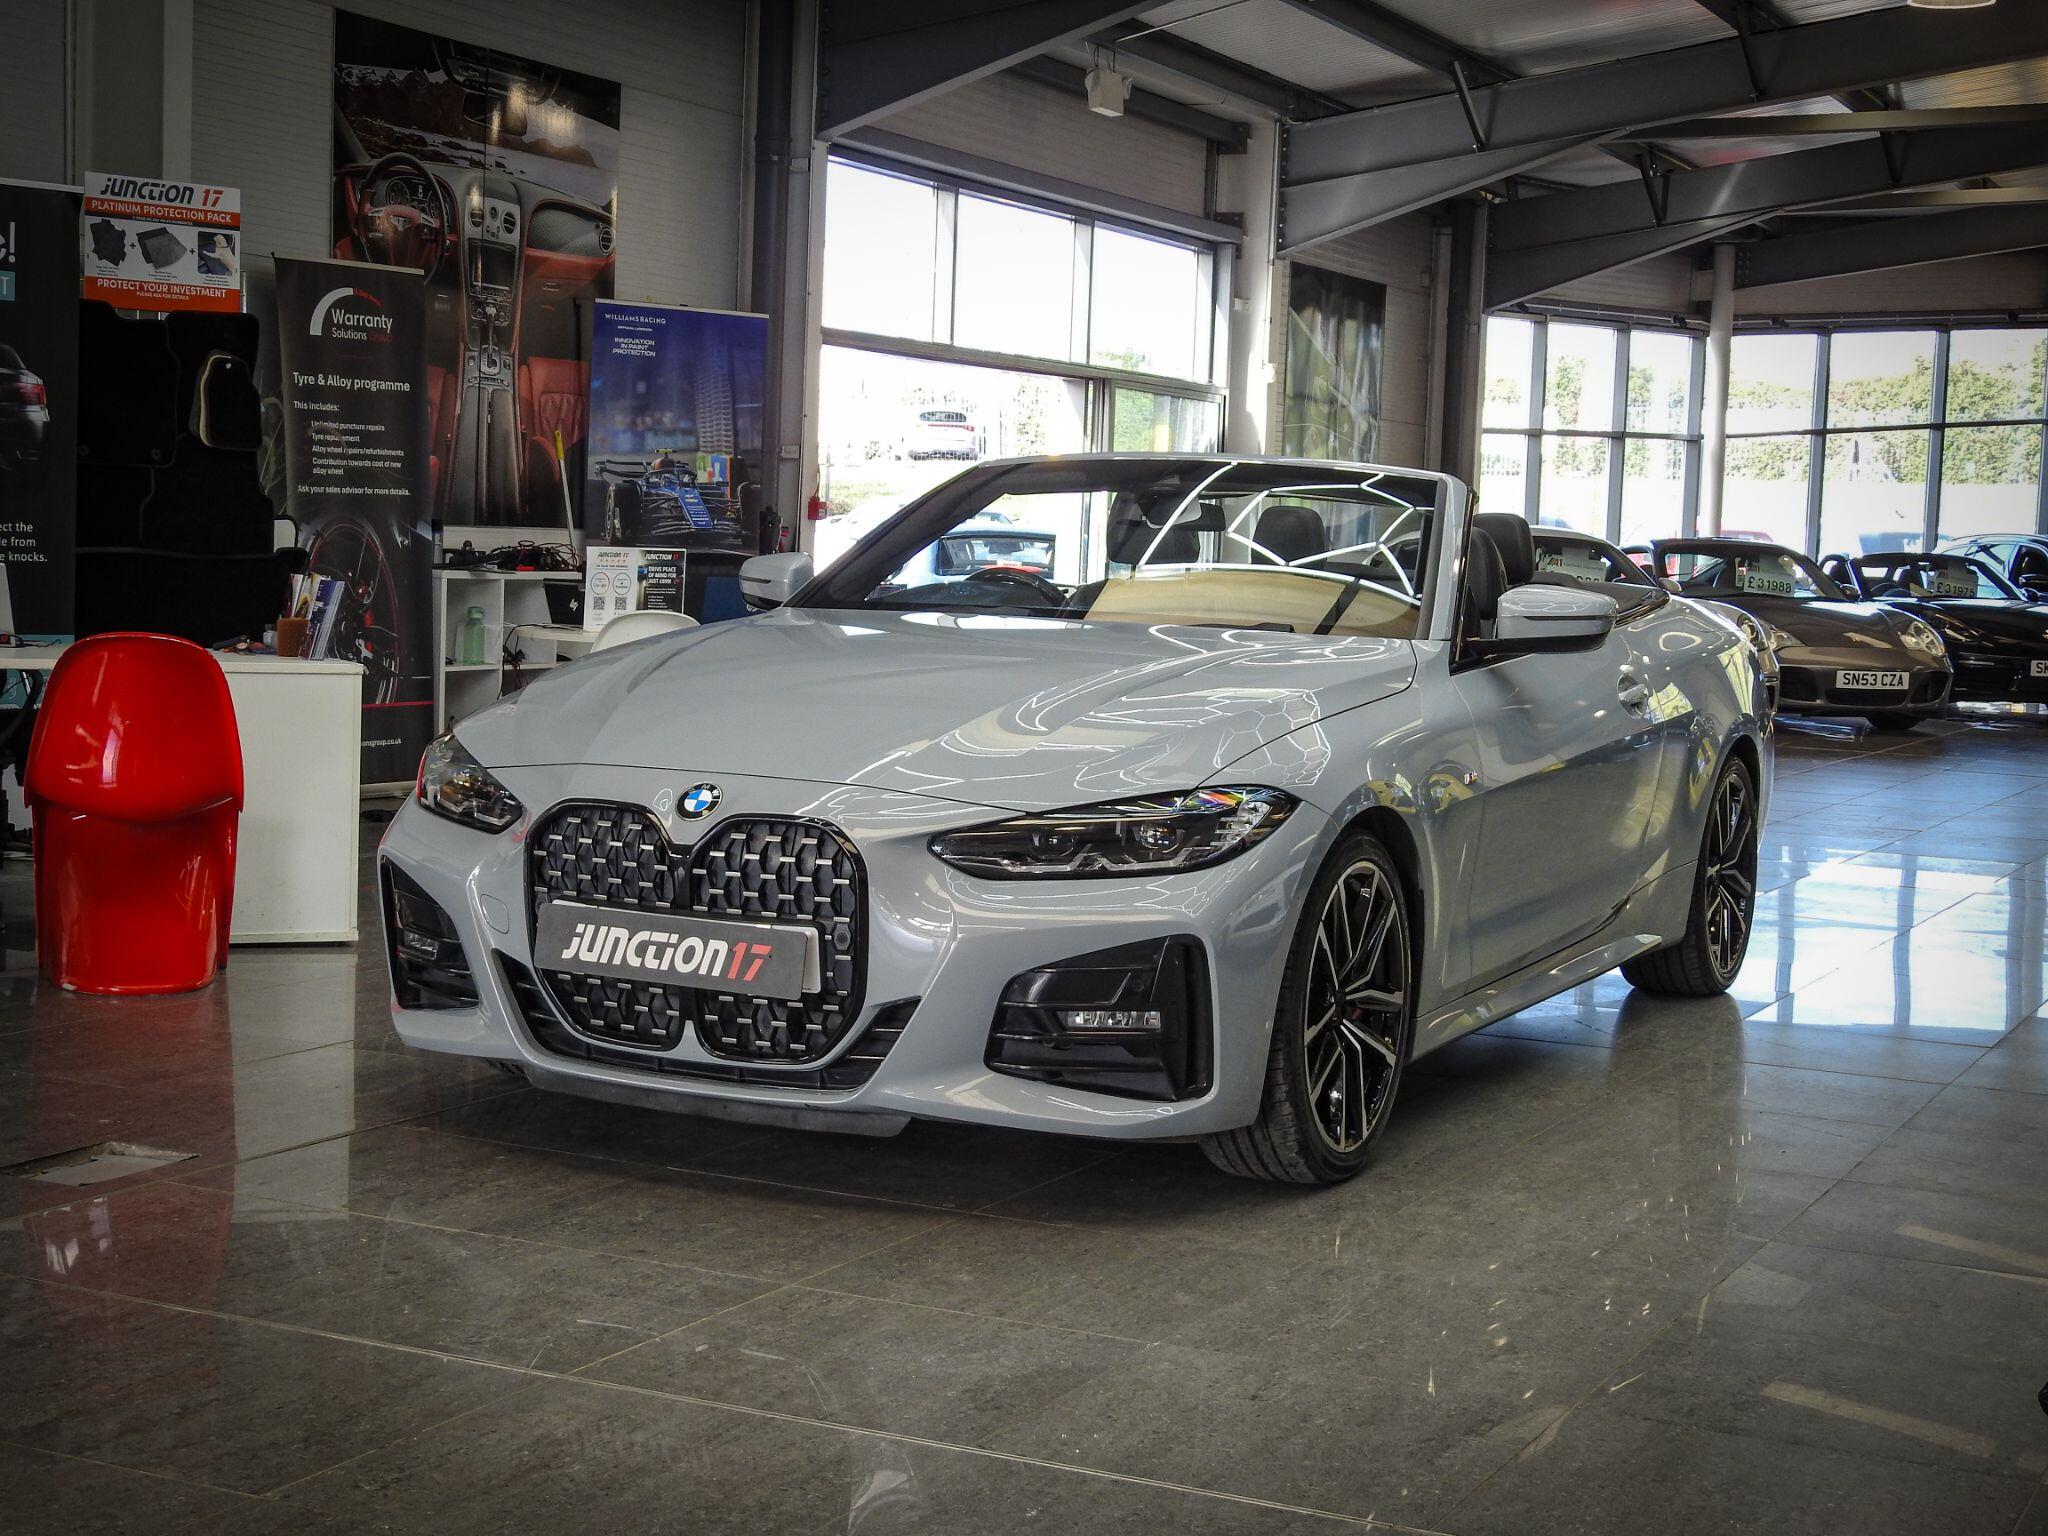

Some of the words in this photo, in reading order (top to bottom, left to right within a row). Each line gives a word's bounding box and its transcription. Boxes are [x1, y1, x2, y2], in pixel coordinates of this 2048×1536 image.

[202, 189, 224, 207] 17
[91, 200, 141, 214] PLATINUM
[144, 205, 204, 220] PROTECTION
[207, 212, 232, 223] PACK
[97, 279, 140, 290] PROTECT
[142, 282, 168, 292] YOUR
[170, 285, 226, 298] INVESTMENT
[331, 309, 393, 334] Warranty
[604, 313, 639, 322] WILLIAMS
[640, 316, 666, 325] RACING
[331, 327, 367, 340] Solutions
[614, 337, 655, 346] INNOVATION
[612, 348, 656, 357] PROTECTION
[293, 372, 315, 386] Tyre
[318, 373, 326, 386] &
[327, 374, 352, 389] Alloy
[354, 379, 410, 392] programme
[293, 400, 309, 410] This
[309, 401, 340, 411] includes:
[339, 422, 366, 431] puncture
[366, 423, 385, 431] repairs
[311, 432, 324, 442] Tyre
[312, 457, 348, 465] Contribution
[348, 458, 371, 467] towards
[310, 486, 326, 494] your
[364, 486, 373, 494] for
[15, 521, 34, 532] the
[10, 536, 36, 546] from
[8, 551, 48, 562] knocks.
[1843, 673, 1877, 686] SN53
[1881, 674, 1904, 687] CZA
